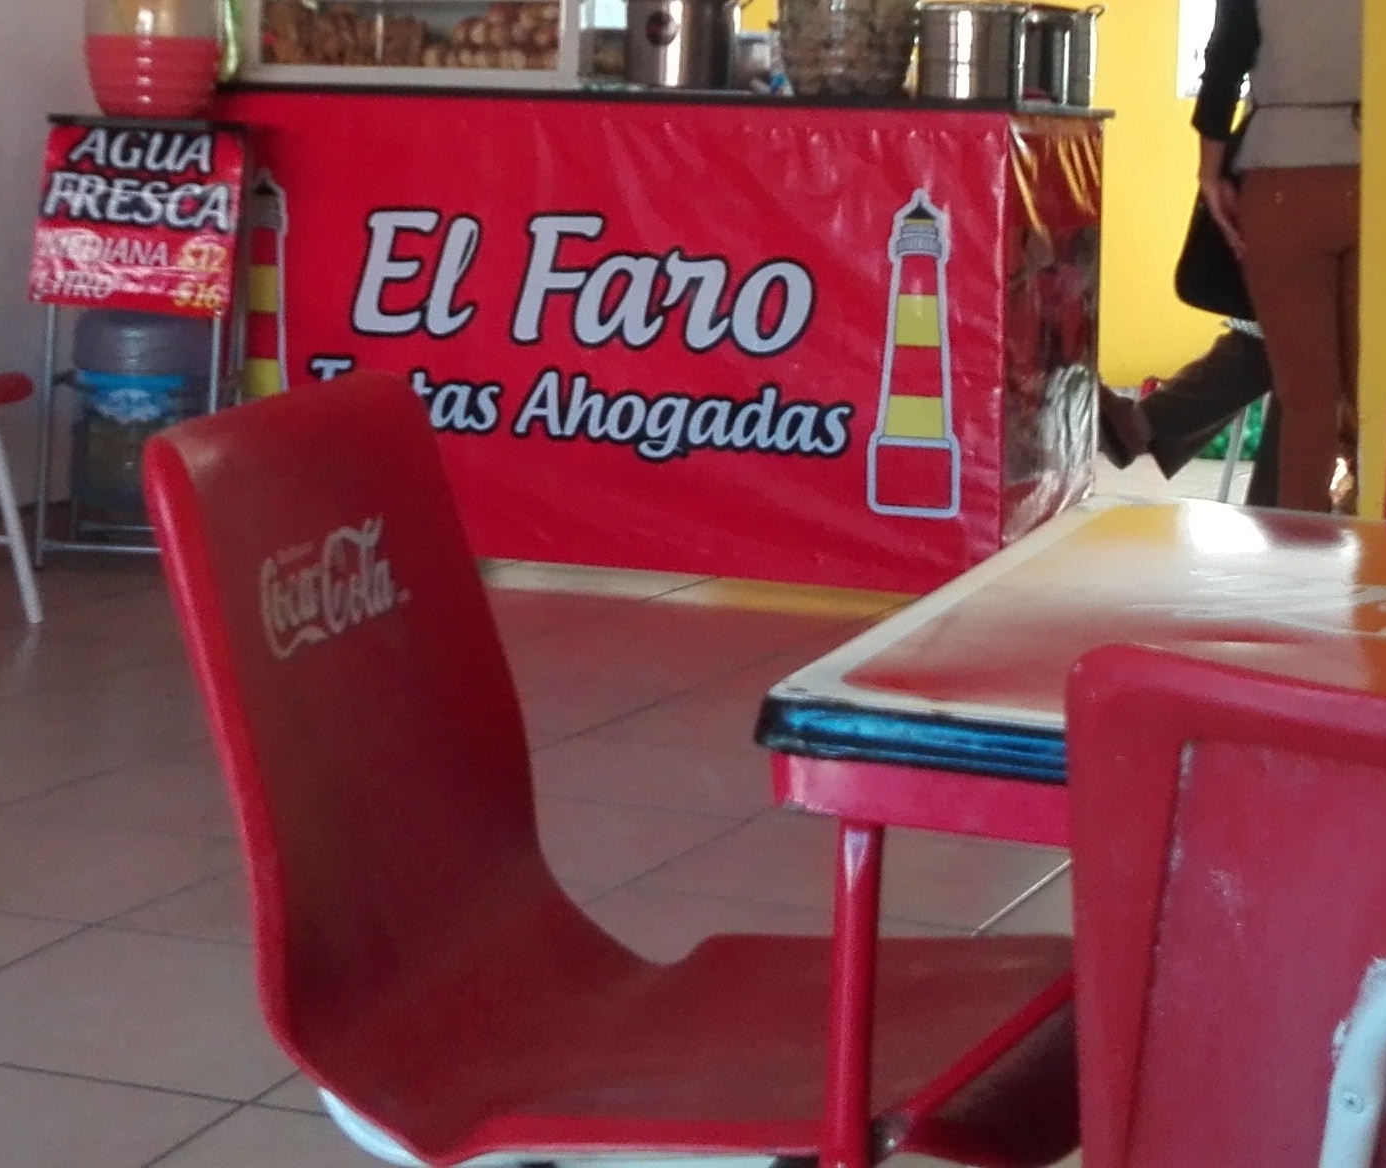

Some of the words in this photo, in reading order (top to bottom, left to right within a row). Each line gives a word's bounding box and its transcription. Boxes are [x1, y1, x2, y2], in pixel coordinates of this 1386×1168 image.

[69, 128, 212, 173] AGUA
[42, 170, 232, 232] FRESCA
[36, 232, 169, 268] IANA
[353, 209, 481, 336] El
[511, 215, 812, 355] Faro
[310, 358, 501, 431] Ttas
[514, 372, 853, 458] Ahogadas
[260, 514, 397, 660] Coca-Cola
